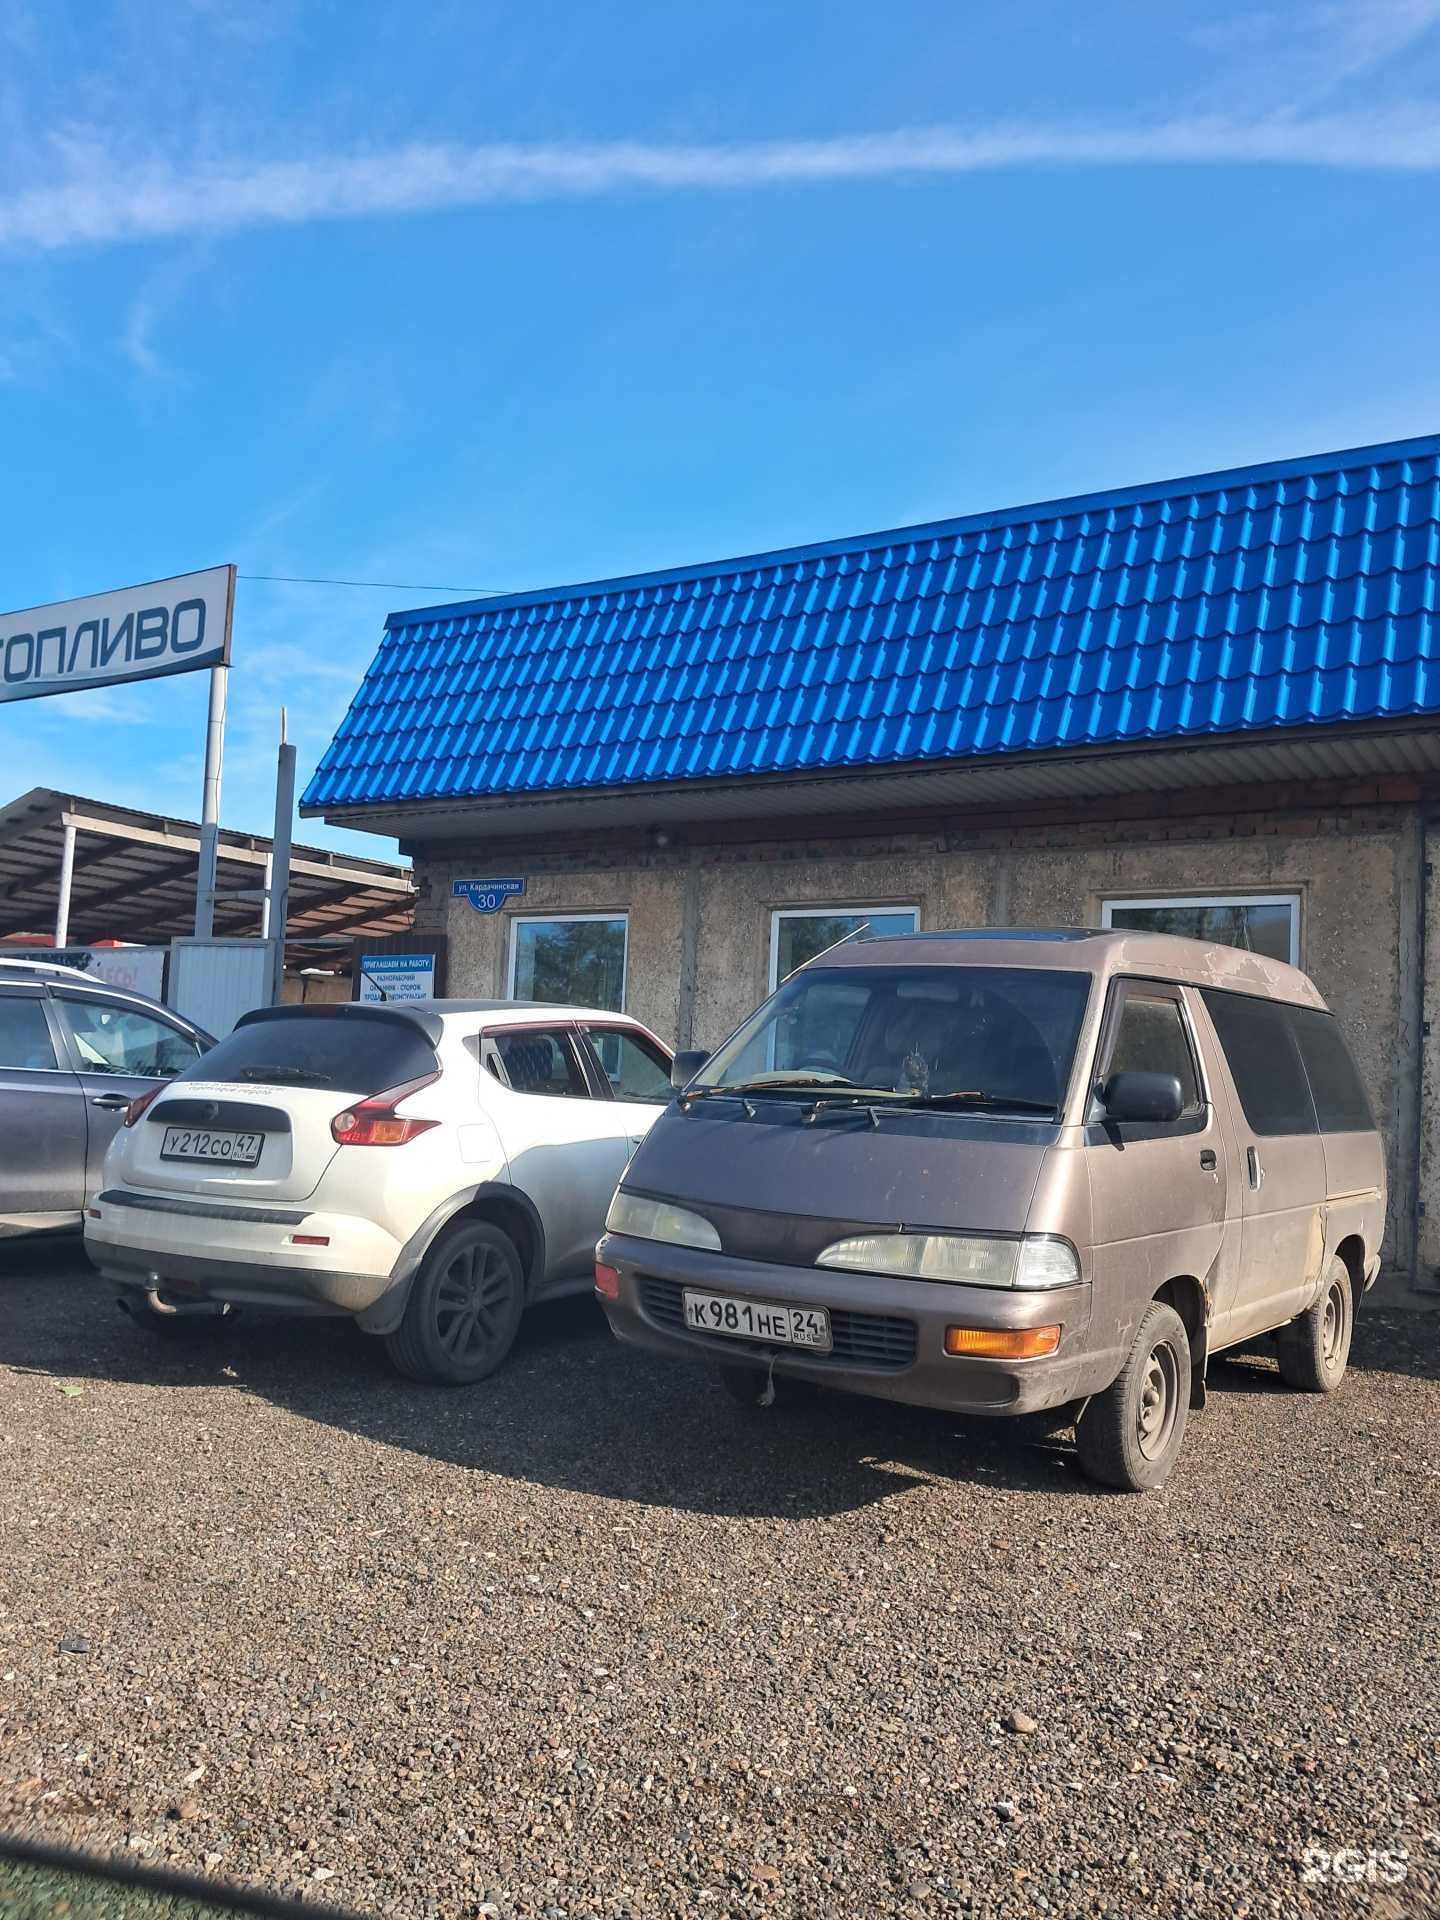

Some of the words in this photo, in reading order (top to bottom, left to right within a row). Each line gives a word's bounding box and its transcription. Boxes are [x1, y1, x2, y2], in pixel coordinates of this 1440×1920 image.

[0, 598, 206, 683] ОПЛИВО
[478, 894, 496, 908] 30
[363, 960, 398, 969] ПРИГЛАШАЕМ
[400, 960, 408, 968] НА
[169, 1132, 232, 1156] У212СО
[237, 1135, 255, 1152] 47
[694, 1300, 787, 1338] К981НЕ
[793, 1311, 818, 1335] 24
[793, 1332, 812, 1342] RUS
